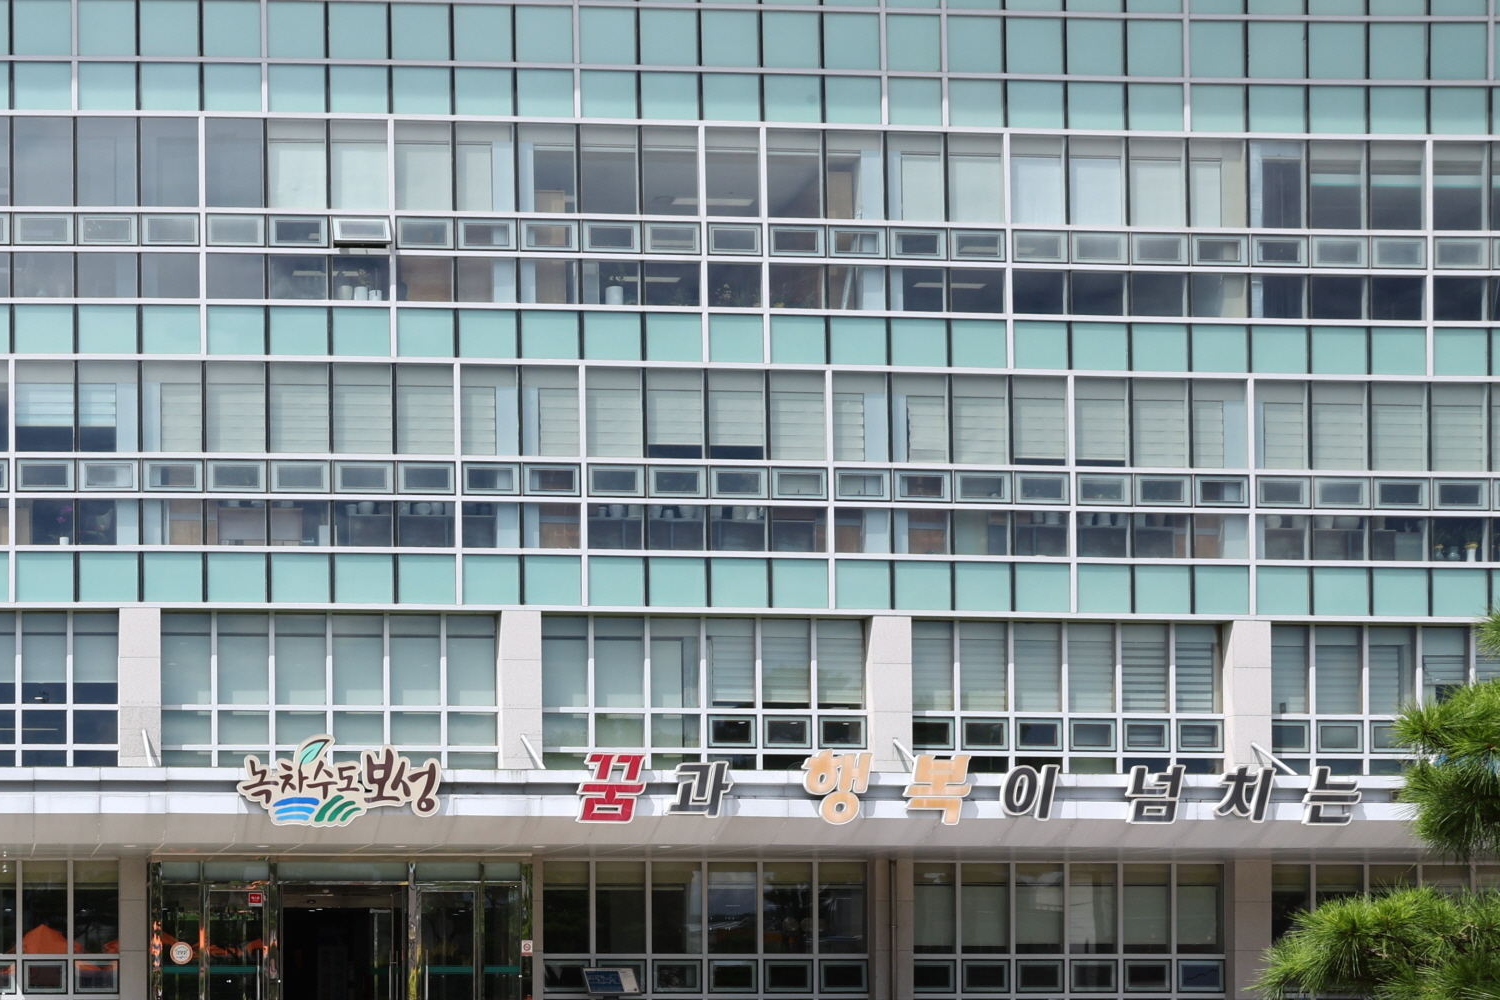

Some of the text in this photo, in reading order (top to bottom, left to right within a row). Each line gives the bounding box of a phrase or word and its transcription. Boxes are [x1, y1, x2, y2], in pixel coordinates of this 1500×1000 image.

[364, 748, 436, 812] 보성
[578, 749, 1362, 825] 꿈과 행복이 넘치는
